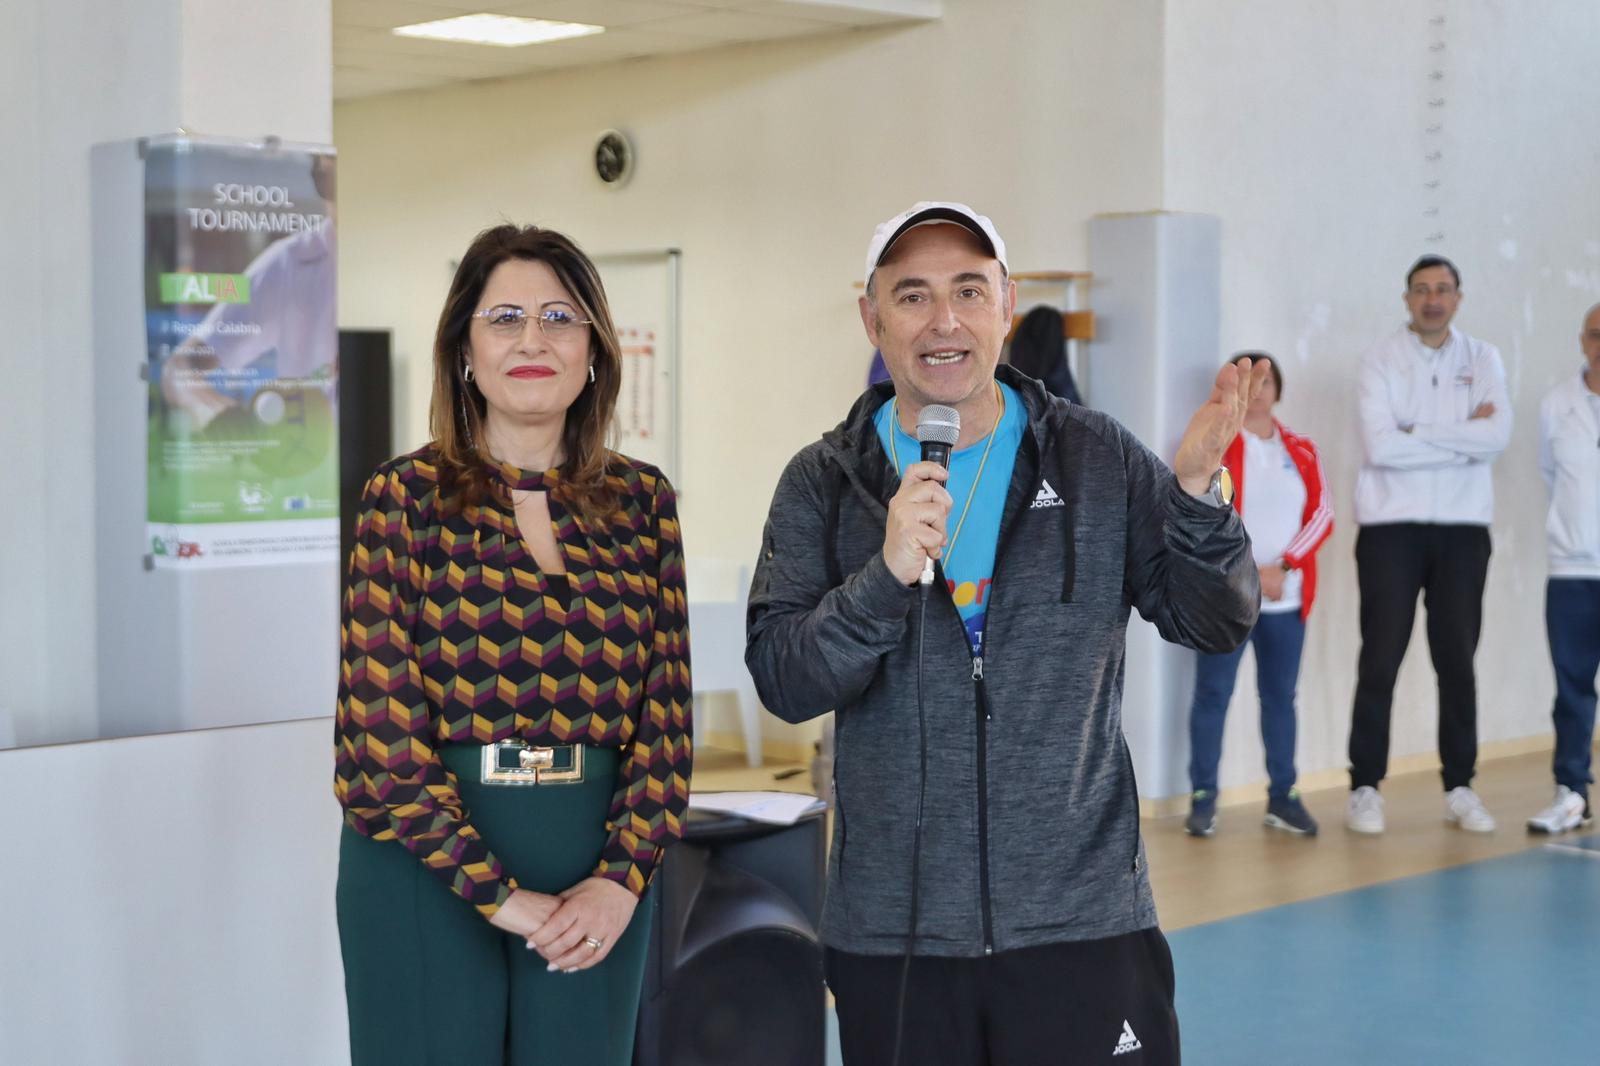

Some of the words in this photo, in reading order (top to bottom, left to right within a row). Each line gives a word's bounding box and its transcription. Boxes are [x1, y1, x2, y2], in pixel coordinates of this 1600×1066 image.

[213, 183, 294, 208] SCHOOL
[188, 208, 323, 233] TOURNAMENT
[1030, 498, 1065, 509] JOOLA
[1112, 1040, 1141, 1055] JOOLA
